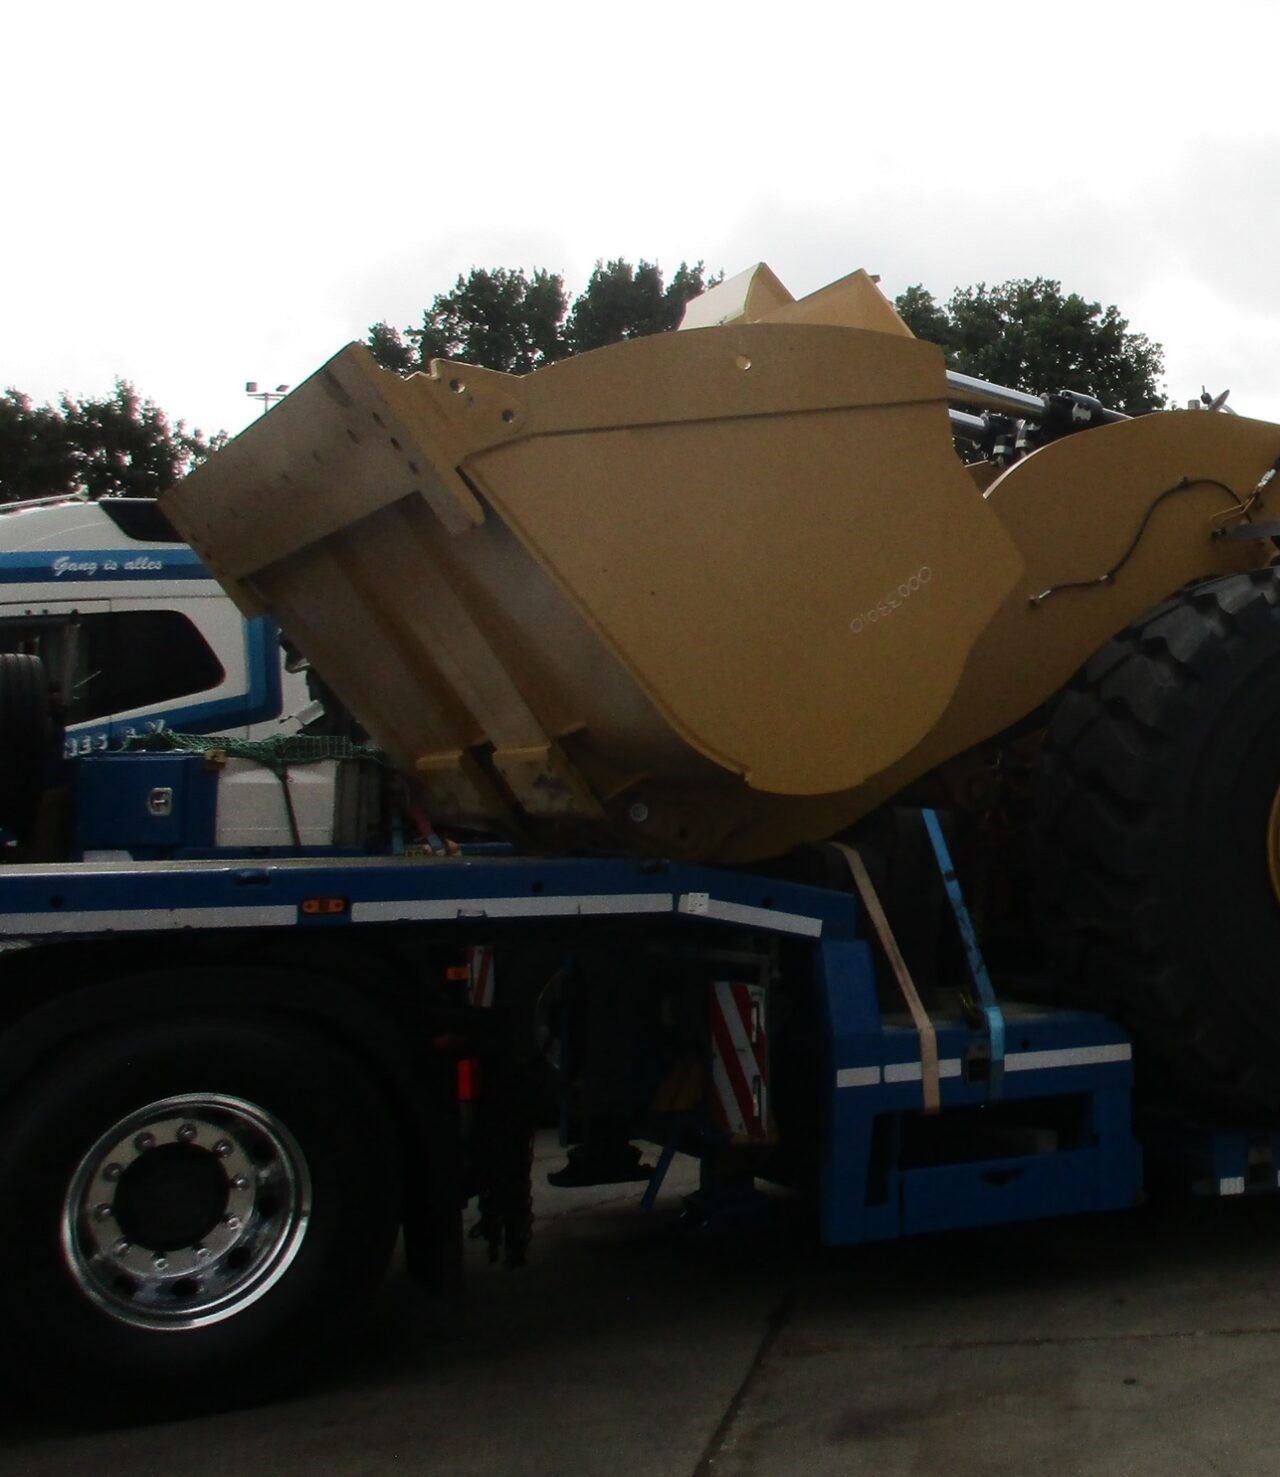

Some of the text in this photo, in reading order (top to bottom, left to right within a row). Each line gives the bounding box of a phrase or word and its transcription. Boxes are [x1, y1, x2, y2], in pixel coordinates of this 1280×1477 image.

[52, 555, 163, 577] Gang is alles
